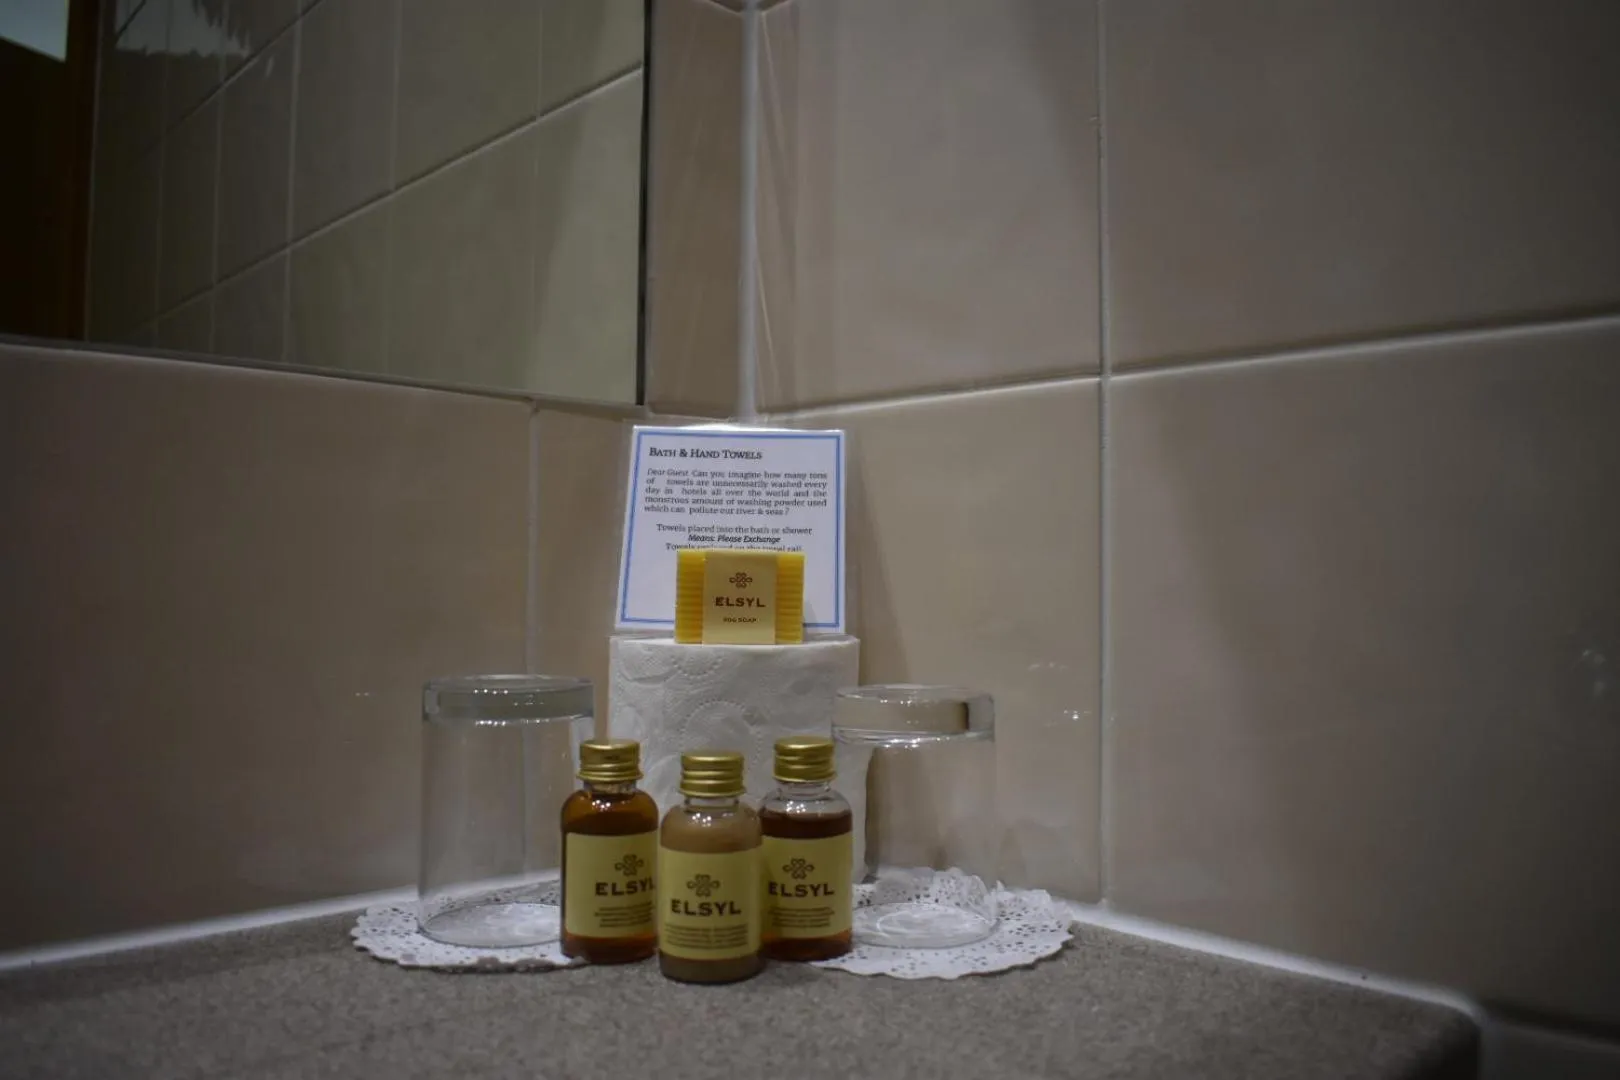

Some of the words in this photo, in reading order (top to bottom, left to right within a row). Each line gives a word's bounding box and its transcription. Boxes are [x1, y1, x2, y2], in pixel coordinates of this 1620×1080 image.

[649, 446, 677, 457] BATH
[679, 448, 688, 457] &
[690, 448, 720, 459] HAND
[722, 449, 763, 460] TOWELS
[691, 469, 708, 477] Can
[710, 471, 726, 479] you
[728, 471, 762, 480] imagine
[764, 470, 781, 479] how
[784, 472, 807, 481] many
[646, 477, 656, 485] of
[666, 478, 695, 486] towels
[712, 480, 769, 489] unnecessarily
[770, 480, 802, 488] washed
[645, 486, 660, 495] day
[681, 487, 708, 496] hotels
[711, 488, 722, 496] all
[748, 489, 762, 497] the
[765, 489, 790, 497] world
[793, 489, 809, 497] and
[813, 489, 828, 497] the
[737, 498, 772, 507] washing
[774, 498, 805, 507] powder
[807, 498, 827, 507] used
[644, 504, 669, 513] which
[689, 505, 719, 515] pollute
[736, 507, 756, 515] river
[656, 523, 686, 532] Towels
[688, 525, 715, 534] placed
[716, 525, 733, 533] into
[735, 525, 749, 533] the
[750, 526, 770, 534] bath
[782, 526, 813, 535] shower
[717, 534, 742, 543] Please
[743, 535, 781, 544] Exchange
[715, 596, 766, 608] ELSYL
[767, 881, 835, 897] ELSYL
[671, 898, 742, 916] ELSYL
